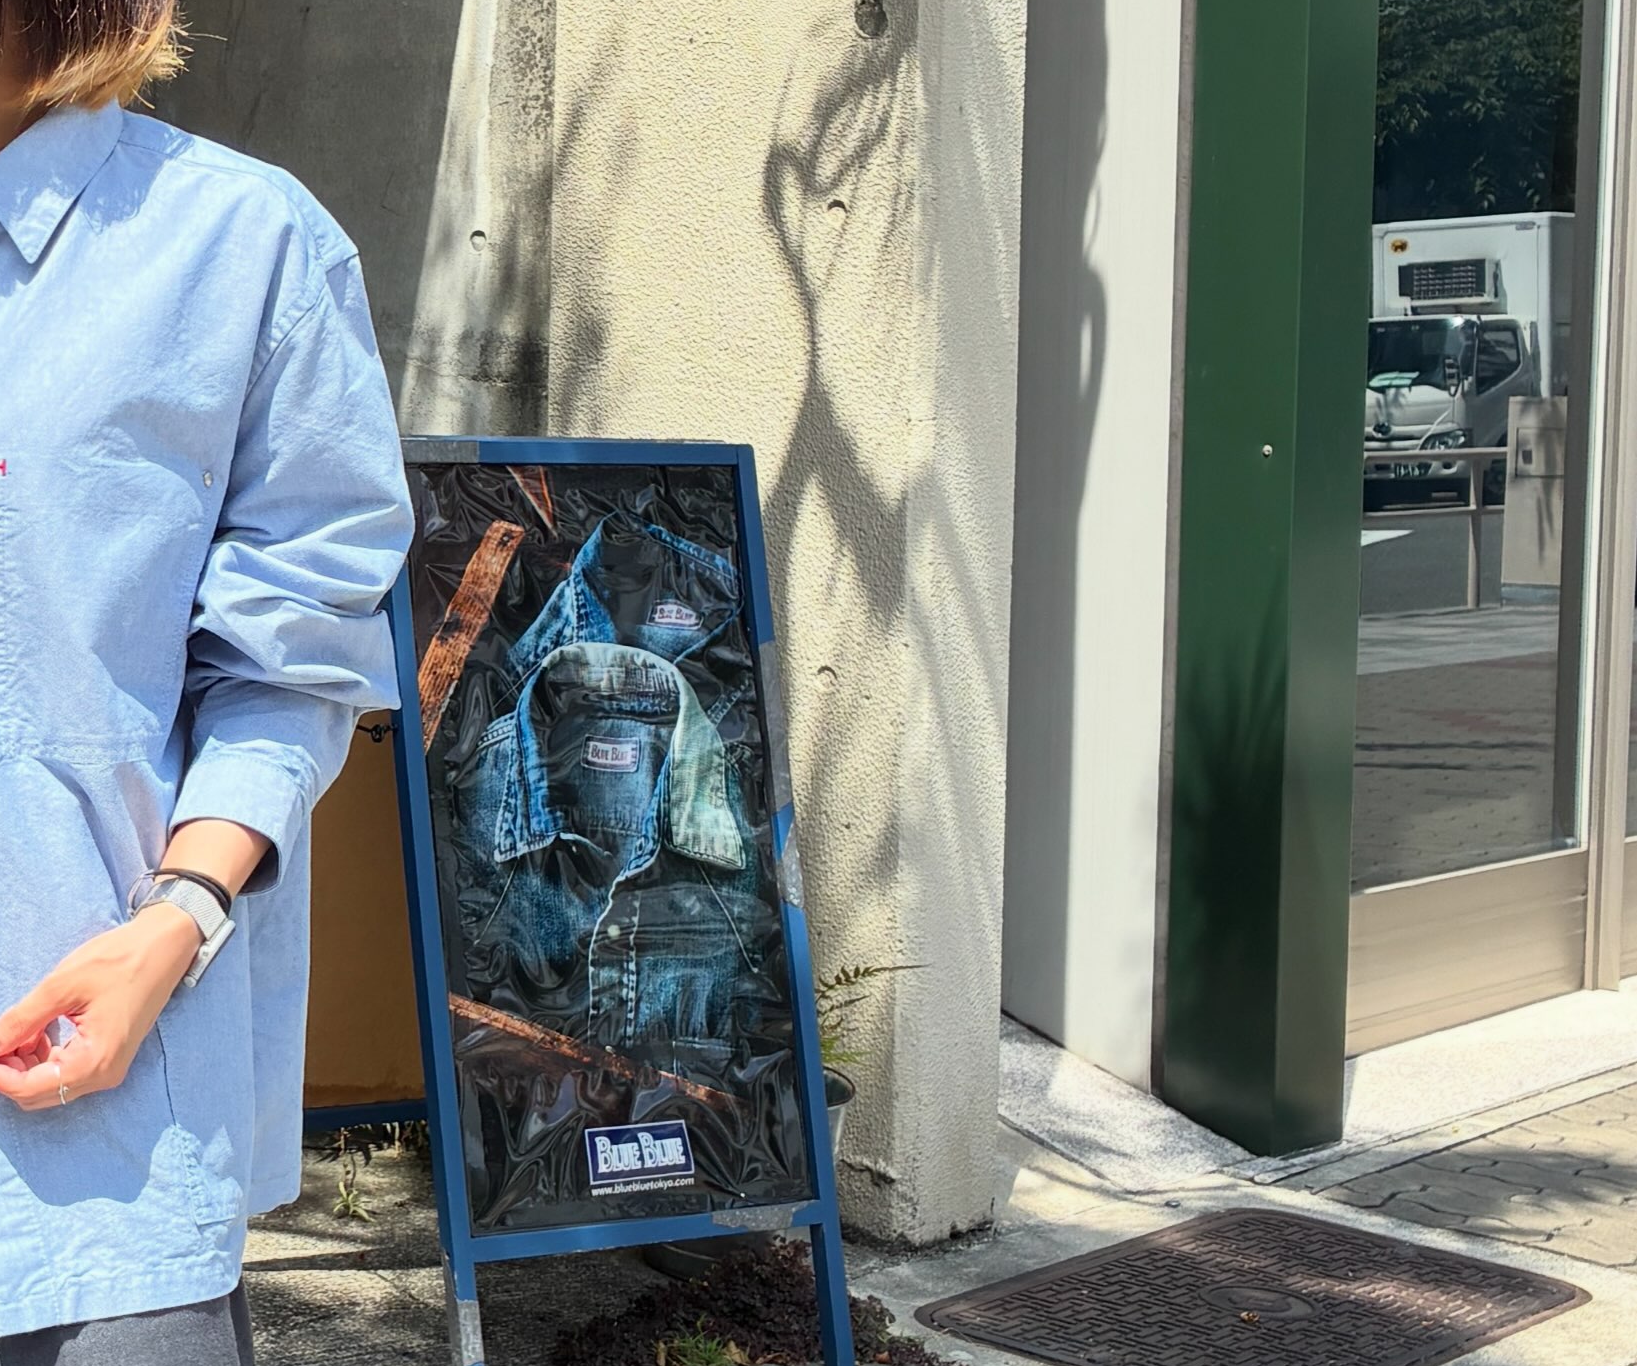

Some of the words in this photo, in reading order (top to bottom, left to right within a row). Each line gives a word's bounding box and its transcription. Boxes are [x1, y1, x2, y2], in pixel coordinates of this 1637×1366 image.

[594, 1136, 642, 1174] BLUE
[637, 1131, 686, 1169] BLUE
[591, 1177, 695, 1197] www.bluebluetokyo.com
